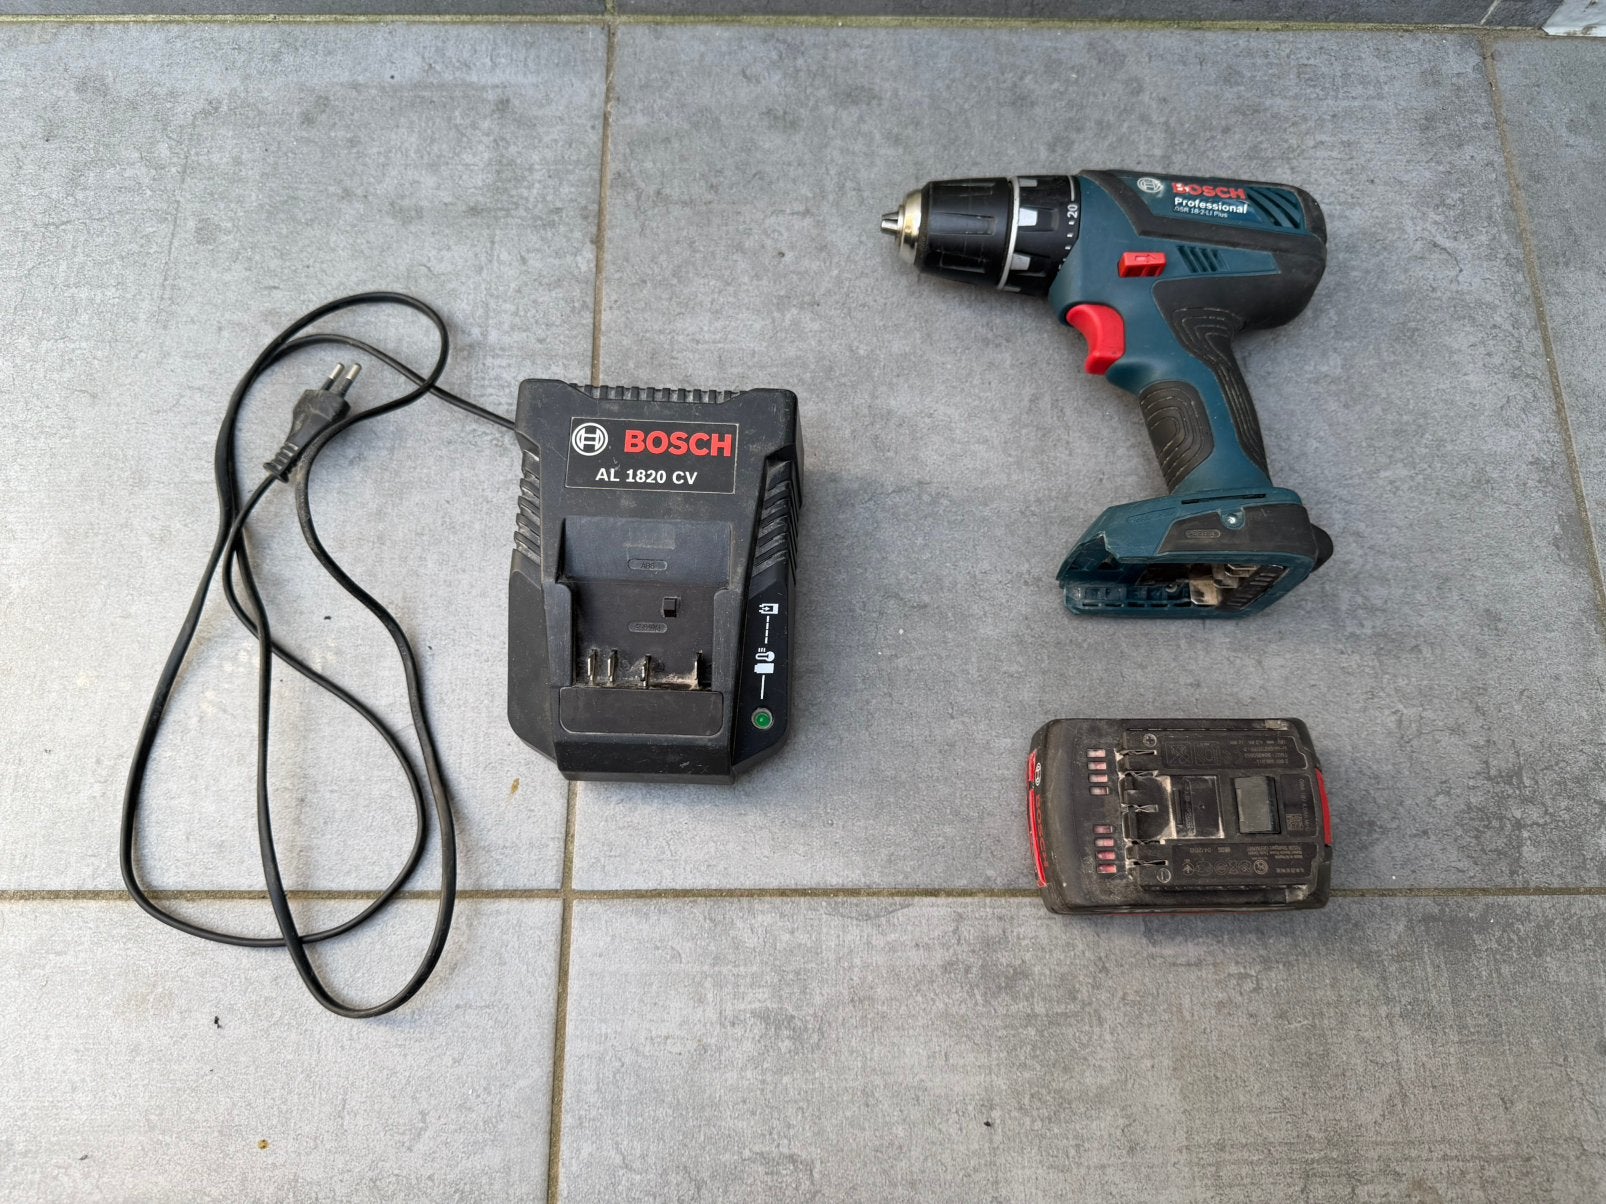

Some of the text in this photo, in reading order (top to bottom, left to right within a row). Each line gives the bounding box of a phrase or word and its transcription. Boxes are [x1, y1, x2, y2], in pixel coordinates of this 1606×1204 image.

[1171, 182, 1247, 200] BOSCH
[1067, 203, 1079, 219] 20
[1174, 196, 1249, 215] Professional
[624, 429, 733, 457] BOSCH
[595, 467, 698, 485] AL 1820 CV
